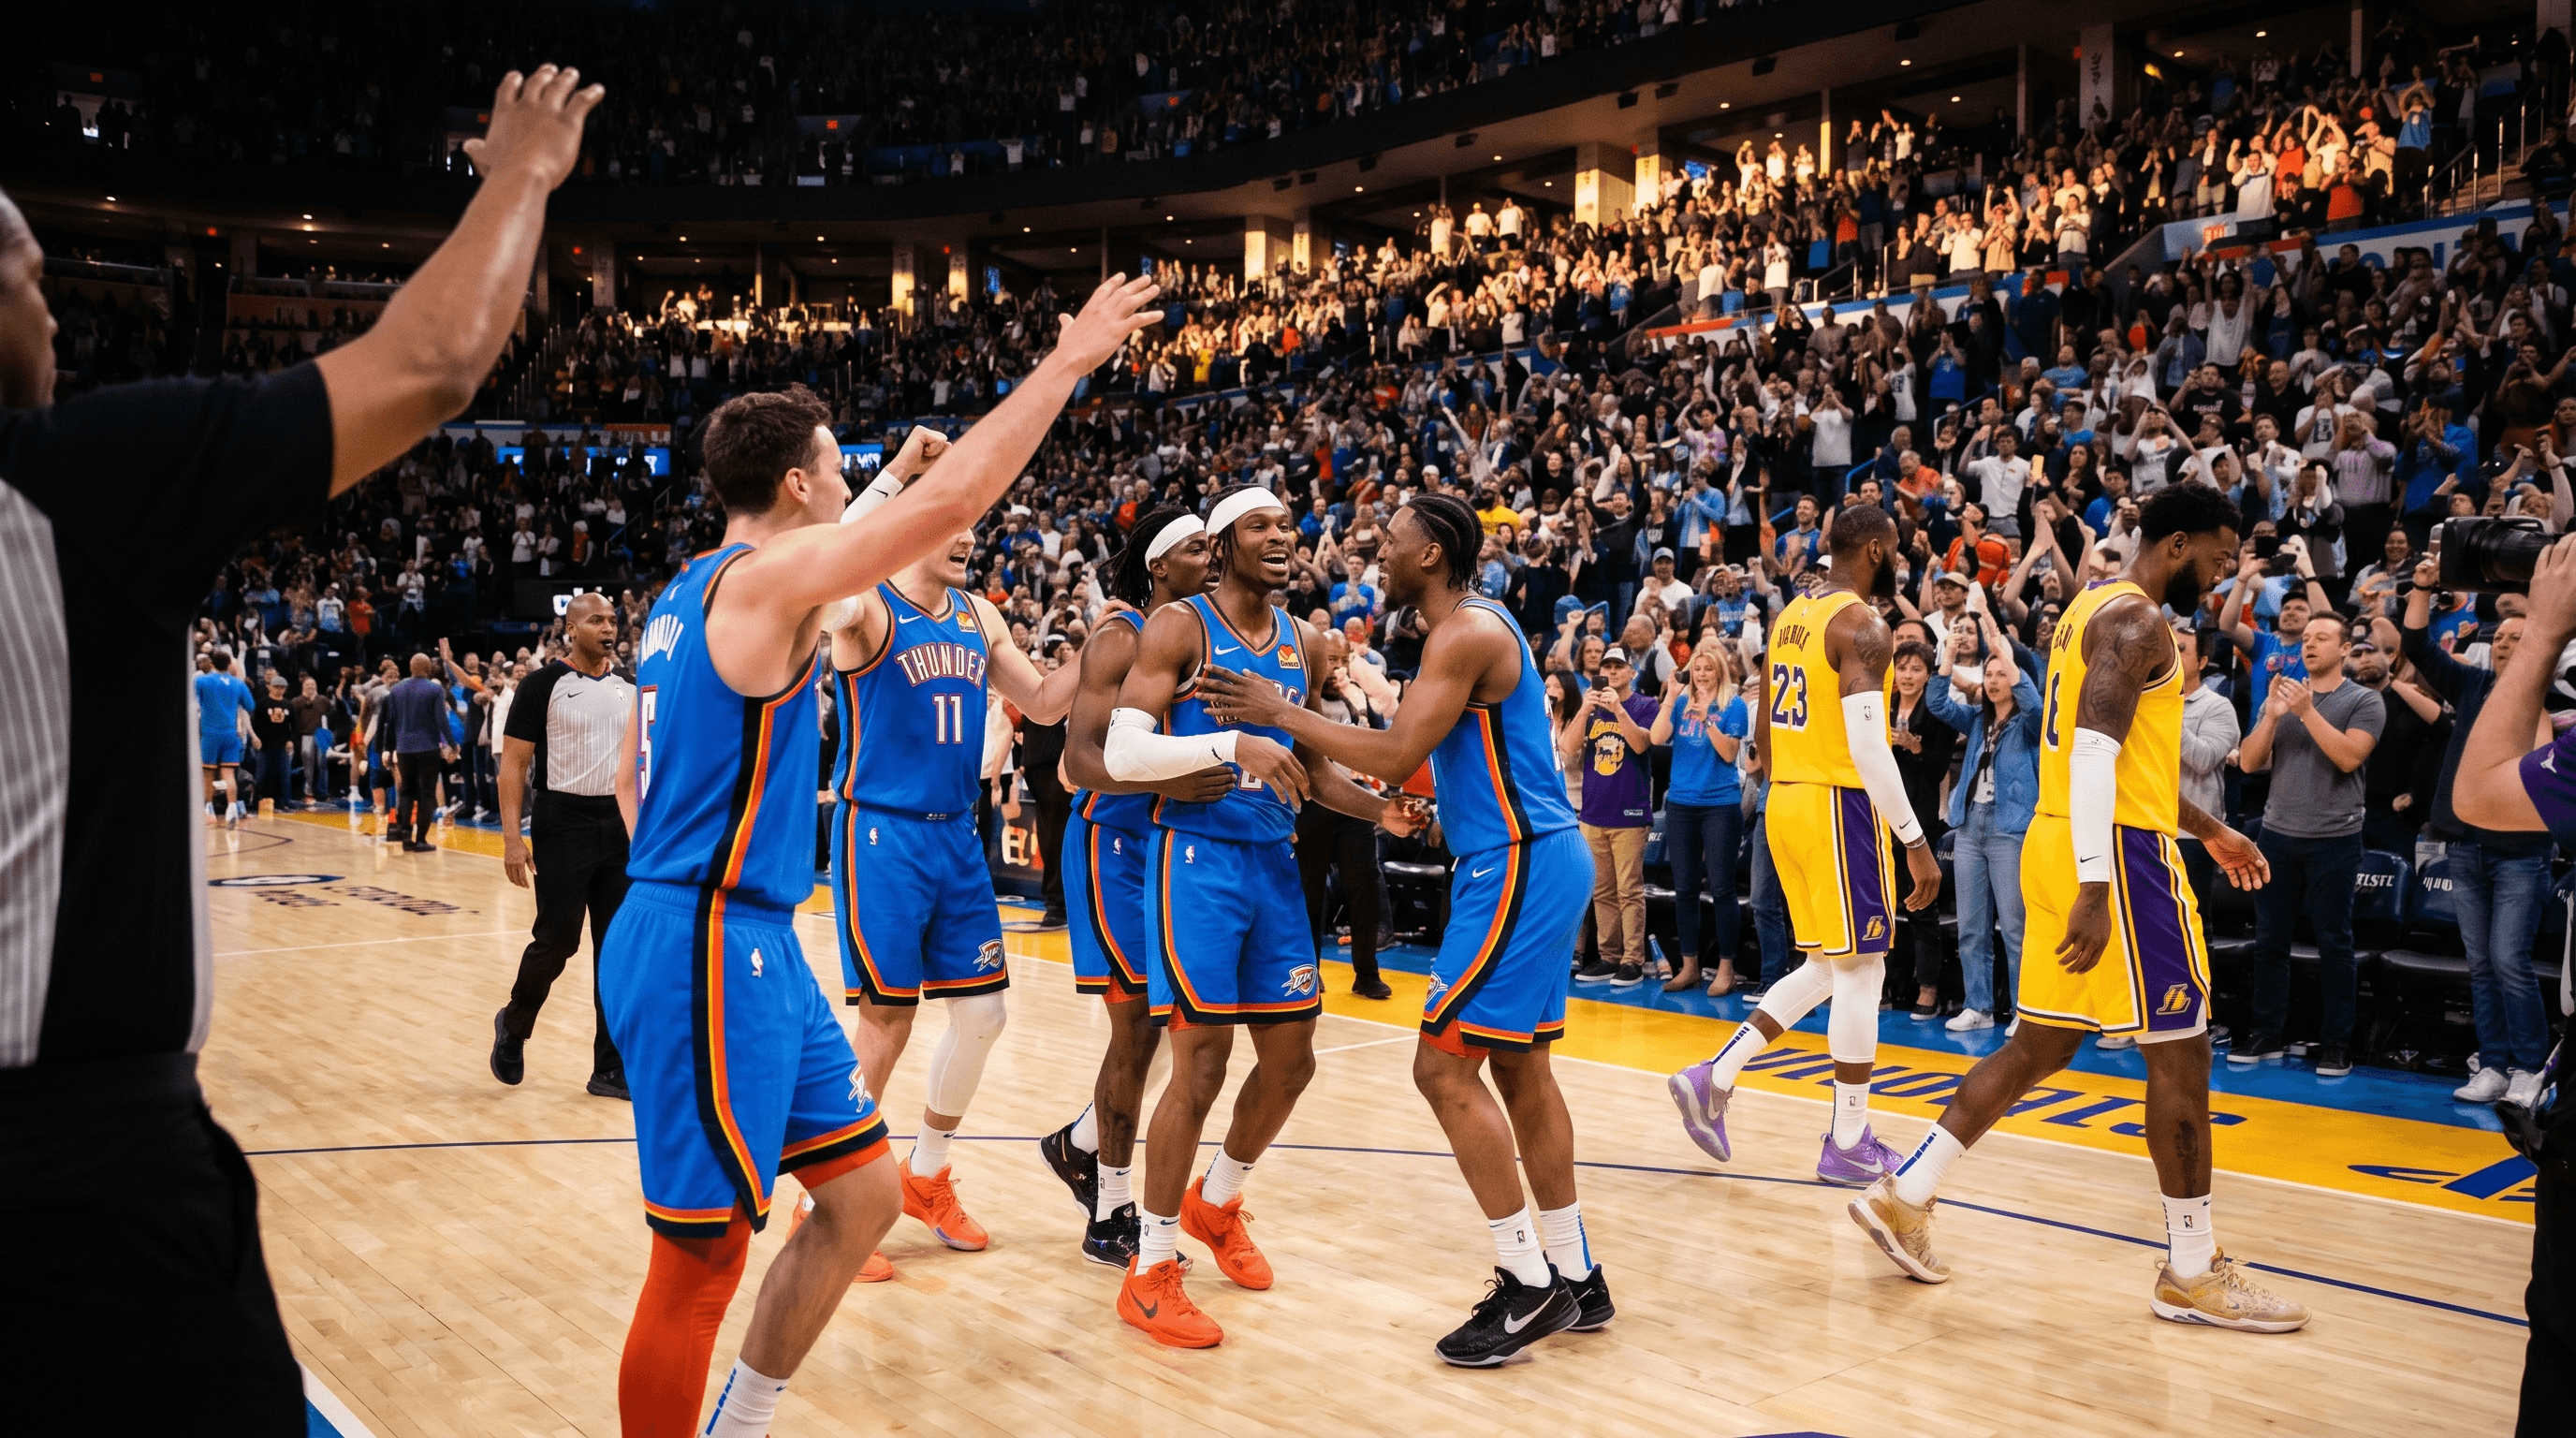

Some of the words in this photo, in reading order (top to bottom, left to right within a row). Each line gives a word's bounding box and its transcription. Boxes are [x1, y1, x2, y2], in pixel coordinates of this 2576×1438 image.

[894, 642, 986, 690] THUNDER
[932, 694, 963, 744] 11
[1771, 663, 1808, 732] 23
